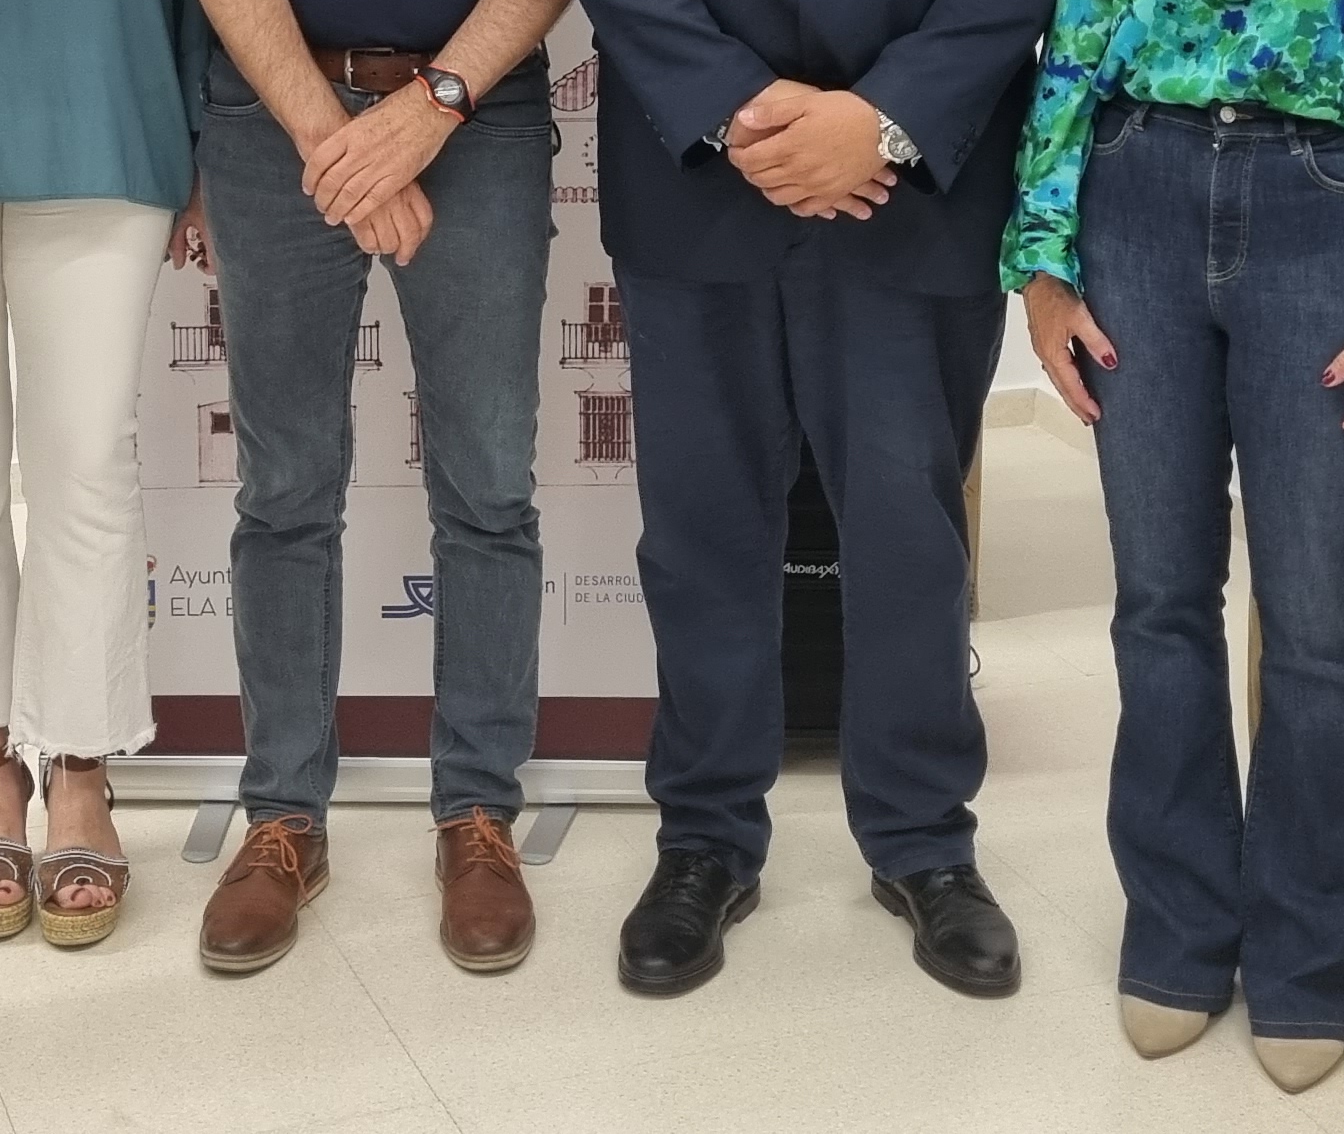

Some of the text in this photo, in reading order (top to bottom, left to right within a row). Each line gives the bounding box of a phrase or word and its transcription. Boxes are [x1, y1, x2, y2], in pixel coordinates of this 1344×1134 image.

[575, 592, 591, 603] DE
[596, 592, 611, 603] LA
[171, 596, 217, 617] ELA
